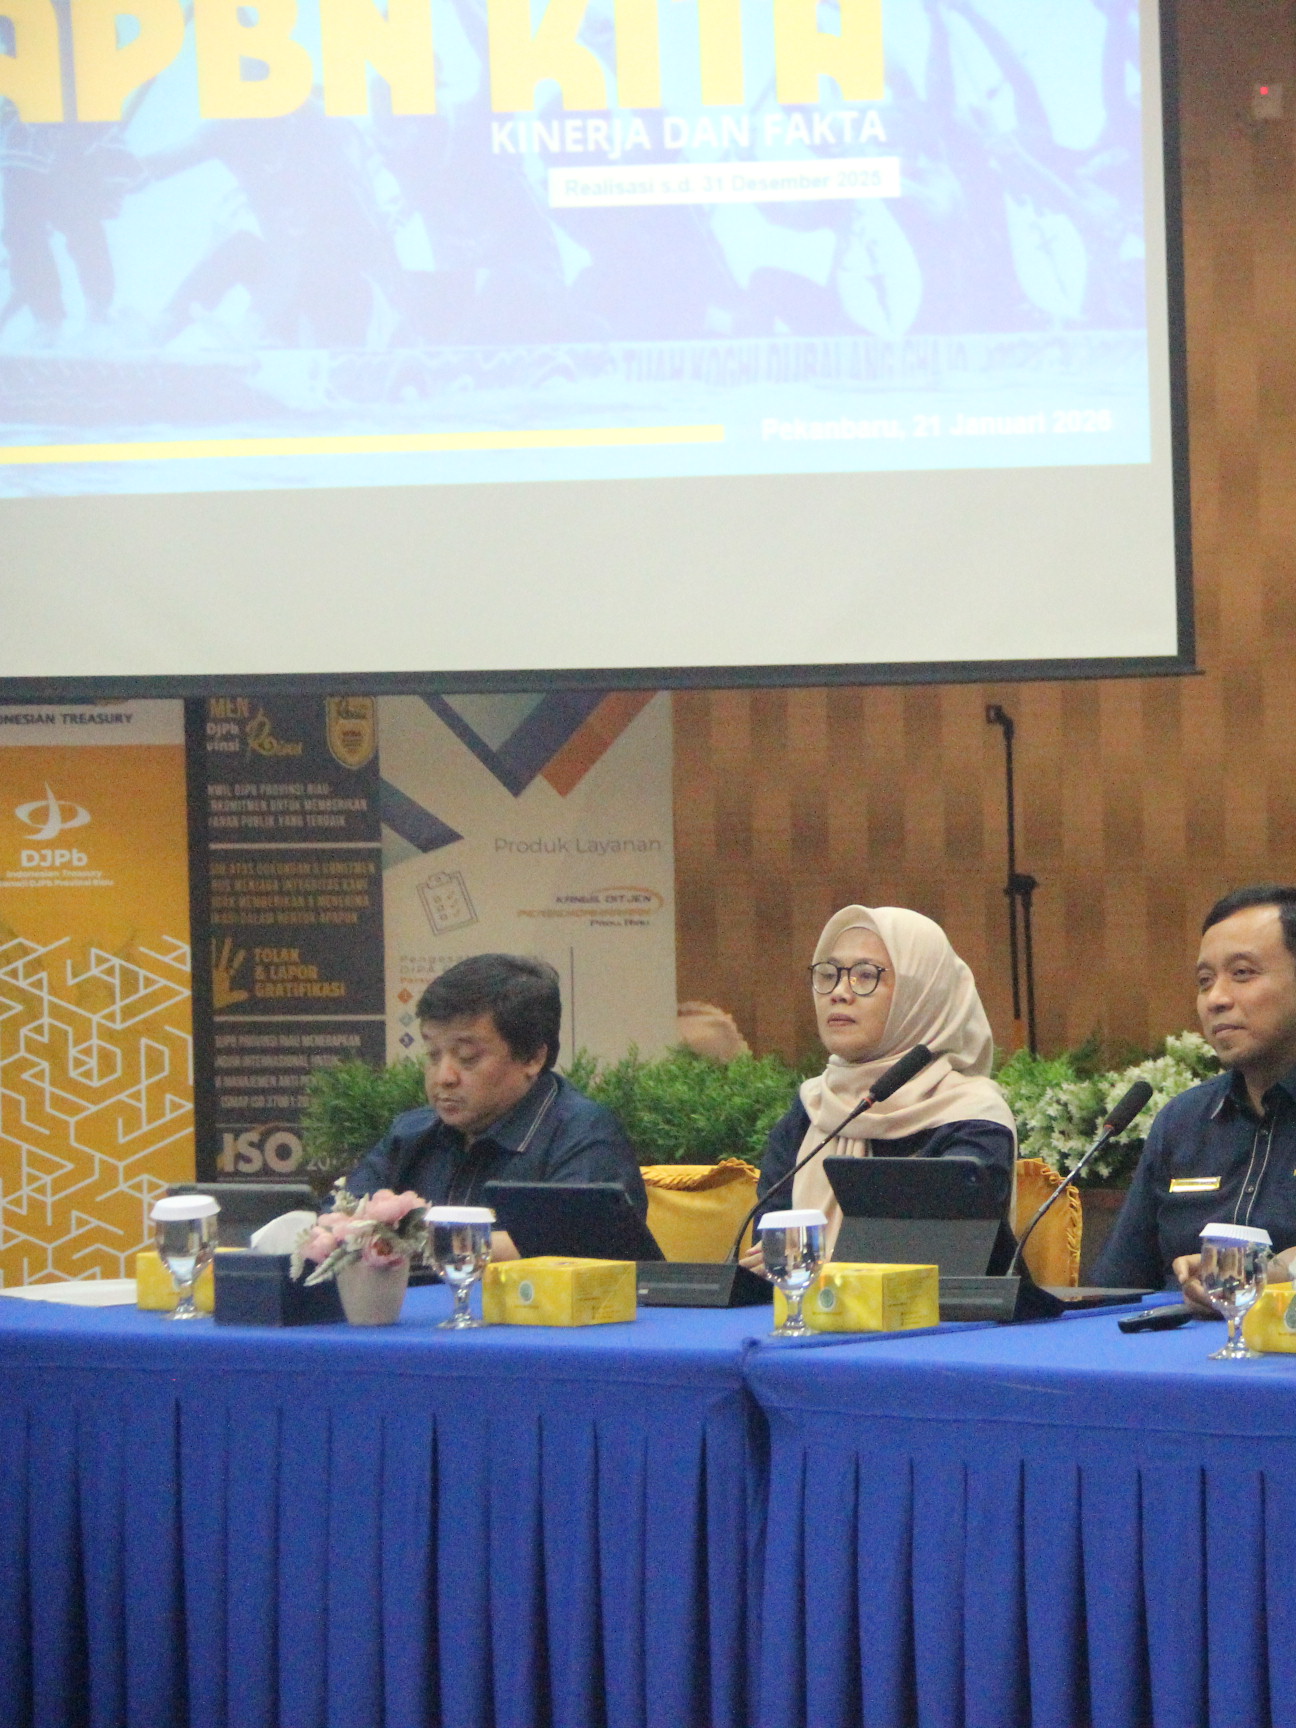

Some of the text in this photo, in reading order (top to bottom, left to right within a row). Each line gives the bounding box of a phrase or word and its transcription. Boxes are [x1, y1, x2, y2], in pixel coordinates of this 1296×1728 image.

[488, 0, 886, 112] KITA
[491, 110, 888, 159] KINERJA DAN FAKTA
[564, 176, 655, 197] Realisasi
[702, 175, 726, 192] 31
[730, 172, 831, 192] Desember
[913, 414, 942, 438] 21
[949, 411, 1047, 436] Januari
[61, 713, 134, 725] TREASURY
[494, 838, 662, 856] Produk Layanan
[20, 849, 88, 867] DJPb
[254, 948, 300, 963] TOLAK
[269, 964, 318, 979] LAPOR
[255, 981, 346, 998] GRATIFIKASI
[221, 1131, 303, 1173] ISO
